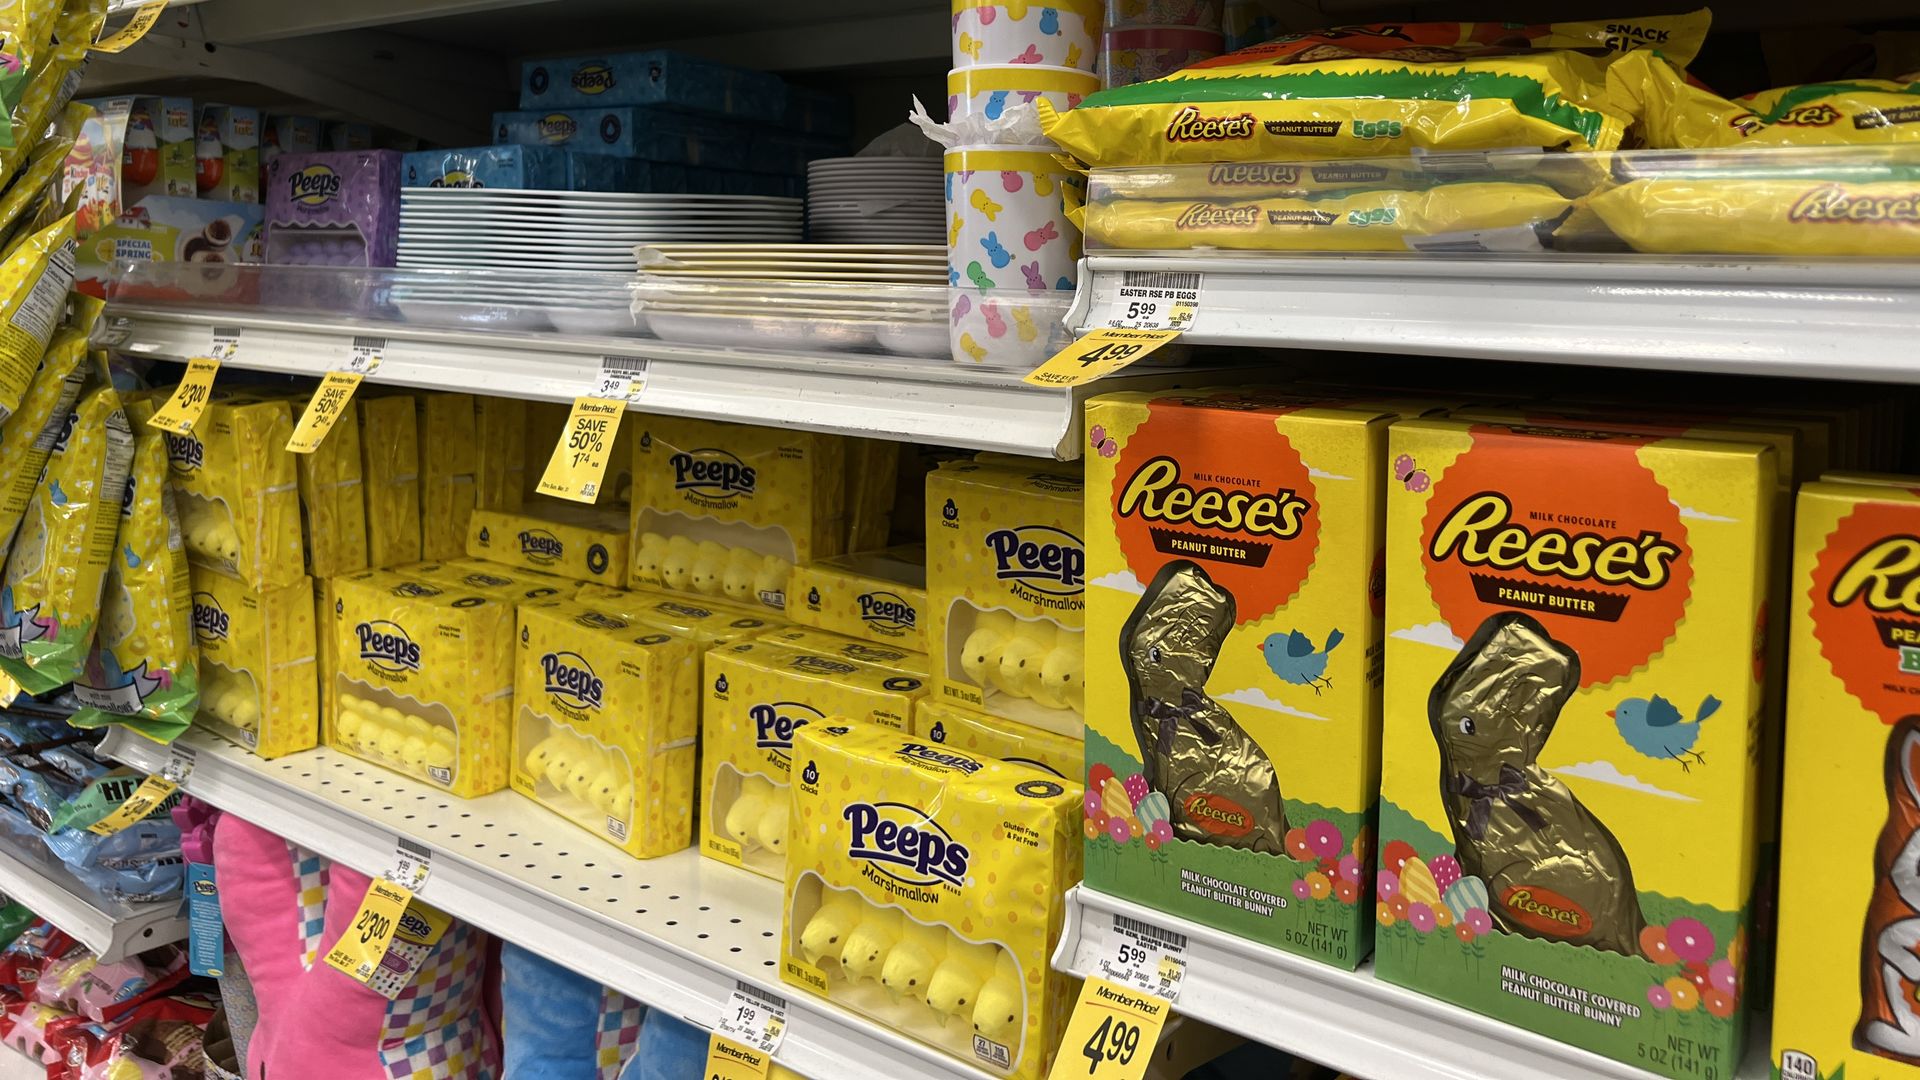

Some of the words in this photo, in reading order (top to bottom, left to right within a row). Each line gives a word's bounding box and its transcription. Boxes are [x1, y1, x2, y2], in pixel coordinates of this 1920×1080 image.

[1605, 23, 1670, 42] SNACK
[571, 67, 618, 89] Peeps
[537, 117, 577, 136] Peeps
[1168, 106, 1256, 142] Reese's
[1271, 125, 1301, 134] PEANUT
[1303, 125, 1334, 134] BUTTER
[1352, 119, 1403, 140] Eggs
[289, 170, 342, 199] Peeps
[1211, 163, 1298, 185] Reeses
[1177, 203, 1260, 230] Reese's
[115, 249, 152, 260] SPRING
[116, 239, 152, 250] SPECIAL
[1120, 288, 1148, 297] EASTER
[1149, 289, 1163, 298] RSE
[1164, 290, 1175, 299] PB
[1176, 291, 1197, 300] EGGS
[323, 388, 347, 400] SAVE
[314, 399, 339, 415] 50%
[577, 418, 608, 433] SAVE
[568, 431, 603, 453] 50%
[669, 453, 757, 491] Peeps
[1193, 471, 1214, 483] MILK
[1214, 474, 1261, 488] CHOCOLATE
[683, 492, 739, 510] Marshmallow
[1119, 457, 1309, 538] Reese's
[945, 506, 955, 516] 10
[1529, 510, 1554, 523] MILK
[1557, 513, 1617, 529] CHOCOLATE
[517, 530, 563, 557] Peeps
[1171, 539, 1209, 554] PEANUT
[1209, 544, 1247, 560] BUTTER
[1431, 493, 1679, 588] Reese's
[985, 529, 1085, 586] Peep
[857, 594, 917, 625] Peeps
[1498, 587, 1546, 605] PEANUT
[1548, 594, 1596, 612] BUTTER
[193, 601, 230, 634] eeps
[355, 622, 421, 665] Peeps
[541, 653, 604, 702] Peeps
[718, 680, 727, 689] 10
[550, 697, 591, 723] Marshmallow
[933, 730, 942, 739] 10
[901, 742, 984, 773] Peeps
[806, 769, 816, 780] 10
[800, 784, 818, 796] Chicks
[1189, 797, 1246, 828] Reese's
[843, 803, 970, 878] Peeps
[1003, 820, 1024, 833] Gluten
[1024, 826, 1040, 838] Free
[1013, 832, 1023, 843] Fat
[1022, 836, 1039, 848] Free
[862, 864, 940, 904] Marshmallow
[943, 884, 962, 897] BRAND
[1181, 868, 1201, 884] MILK
[1202, 874, 1248, 898] CHOCOLATE
[1249, 888, 1288, 910] COVERED
[1181, 881, 1212, 900] PEANUT
[1213, 889, 1242, 908] BUTTER
[1244, 897, 1274, 918] BUNNY
[1507, 890, 1583, 928] Reese's
[1113, 926, 1125, 935] RSE
[1140, 934, 1162, 947] SHAPES
[1162, 942, 1183, 953] BUNNY
[1307, 920, 1330, 937] NET
[1330, 927, 1349, 943] WT
[1136, 940, 1158, 952] EASTER
[1285, 928, 1292, 941] 5
[1294, 931, 1310, 947] OZ
[1311, 937, 1333, 957] (141
[1335, 945, 1348, 961] g)
[1096, 985, 1136, 1008] Member
[1134, 998, 1160, 1016] Price!
[1501, 965, 1527, 984] MILK
[1529, 973, 1590, 1003] CHOCOLATE
[1590, 993, 1642, 1019] COVERED
[1501, 980, 1541, 1002] PEANUT
[1542, 991, 1582, 1016] BUTTER
[1583, 1004, 1623, 1029] BUNNY
[716, 1042, 744, 1060] Member
[1637, 1042, 1646, 1058] 5
[1649, 1047, 1668, 1064] OZ
[1671, 1054, 1700, 1076] (141
[1667, 1034, 1694, 1055] NET
[1698, 1045, 1720, 1064] WT
[1785, 1054, 1813, 1076] 140
